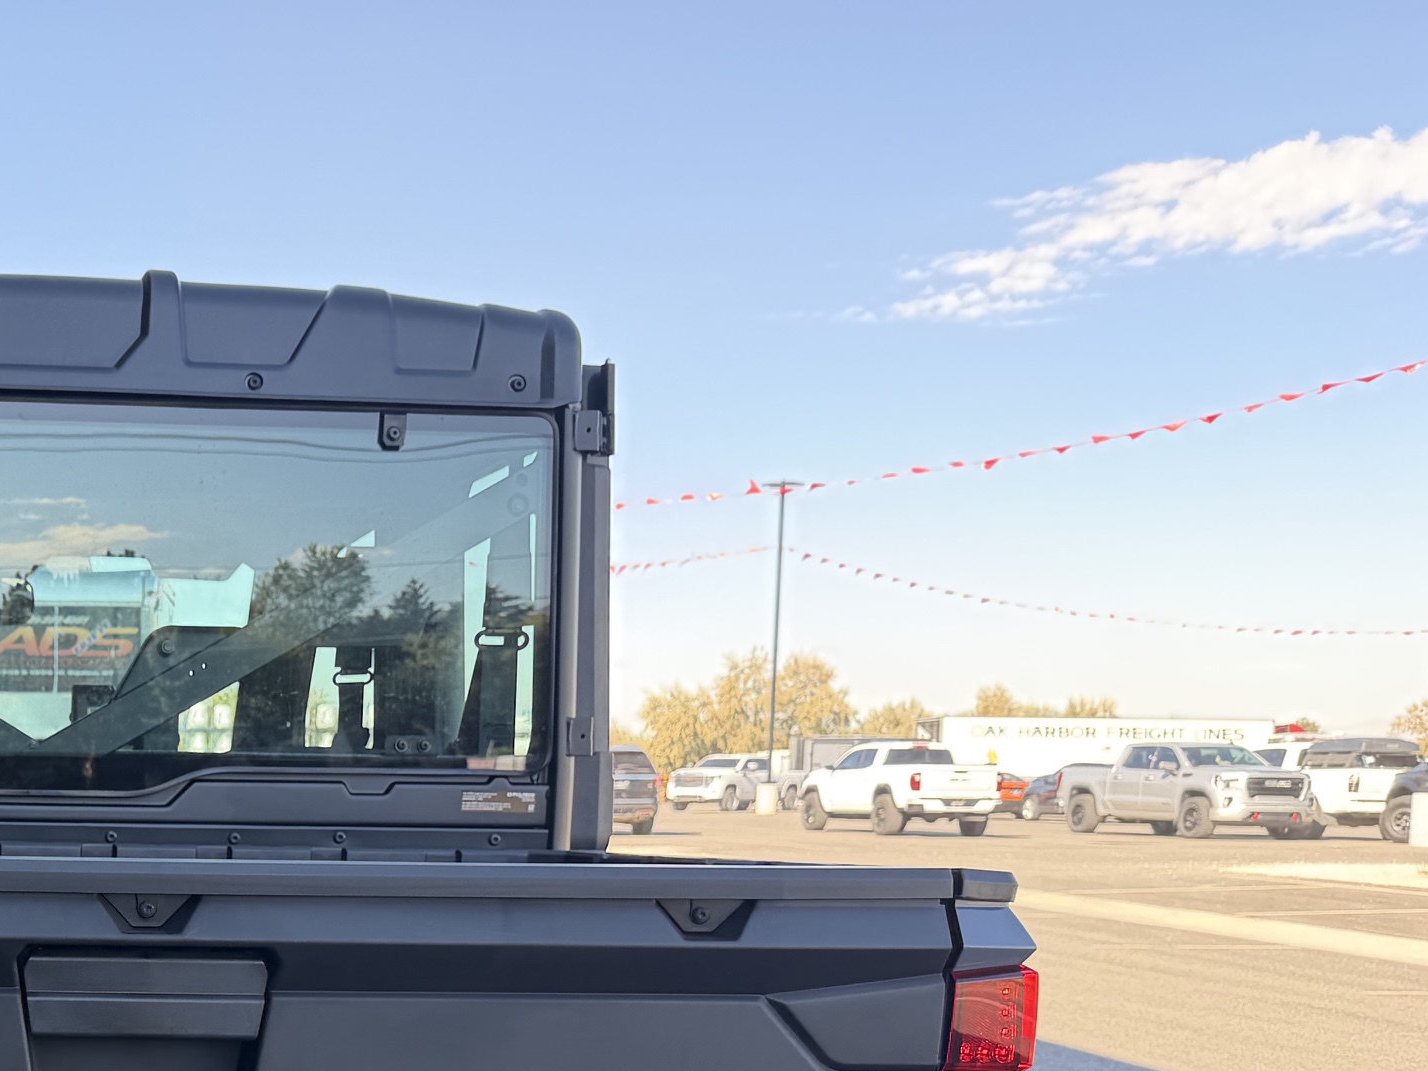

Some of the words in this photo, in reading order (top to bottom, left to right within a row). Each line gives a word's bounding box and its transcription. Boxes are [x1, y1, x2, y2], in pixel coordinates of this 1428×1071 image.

[971, 725, 1007, 738] OAK
[1018, 726, 1096, 738] HARBOR
[1106, 727, 1185, 740] FREIGHT
[1195, 728, 1245, 741] LINES
